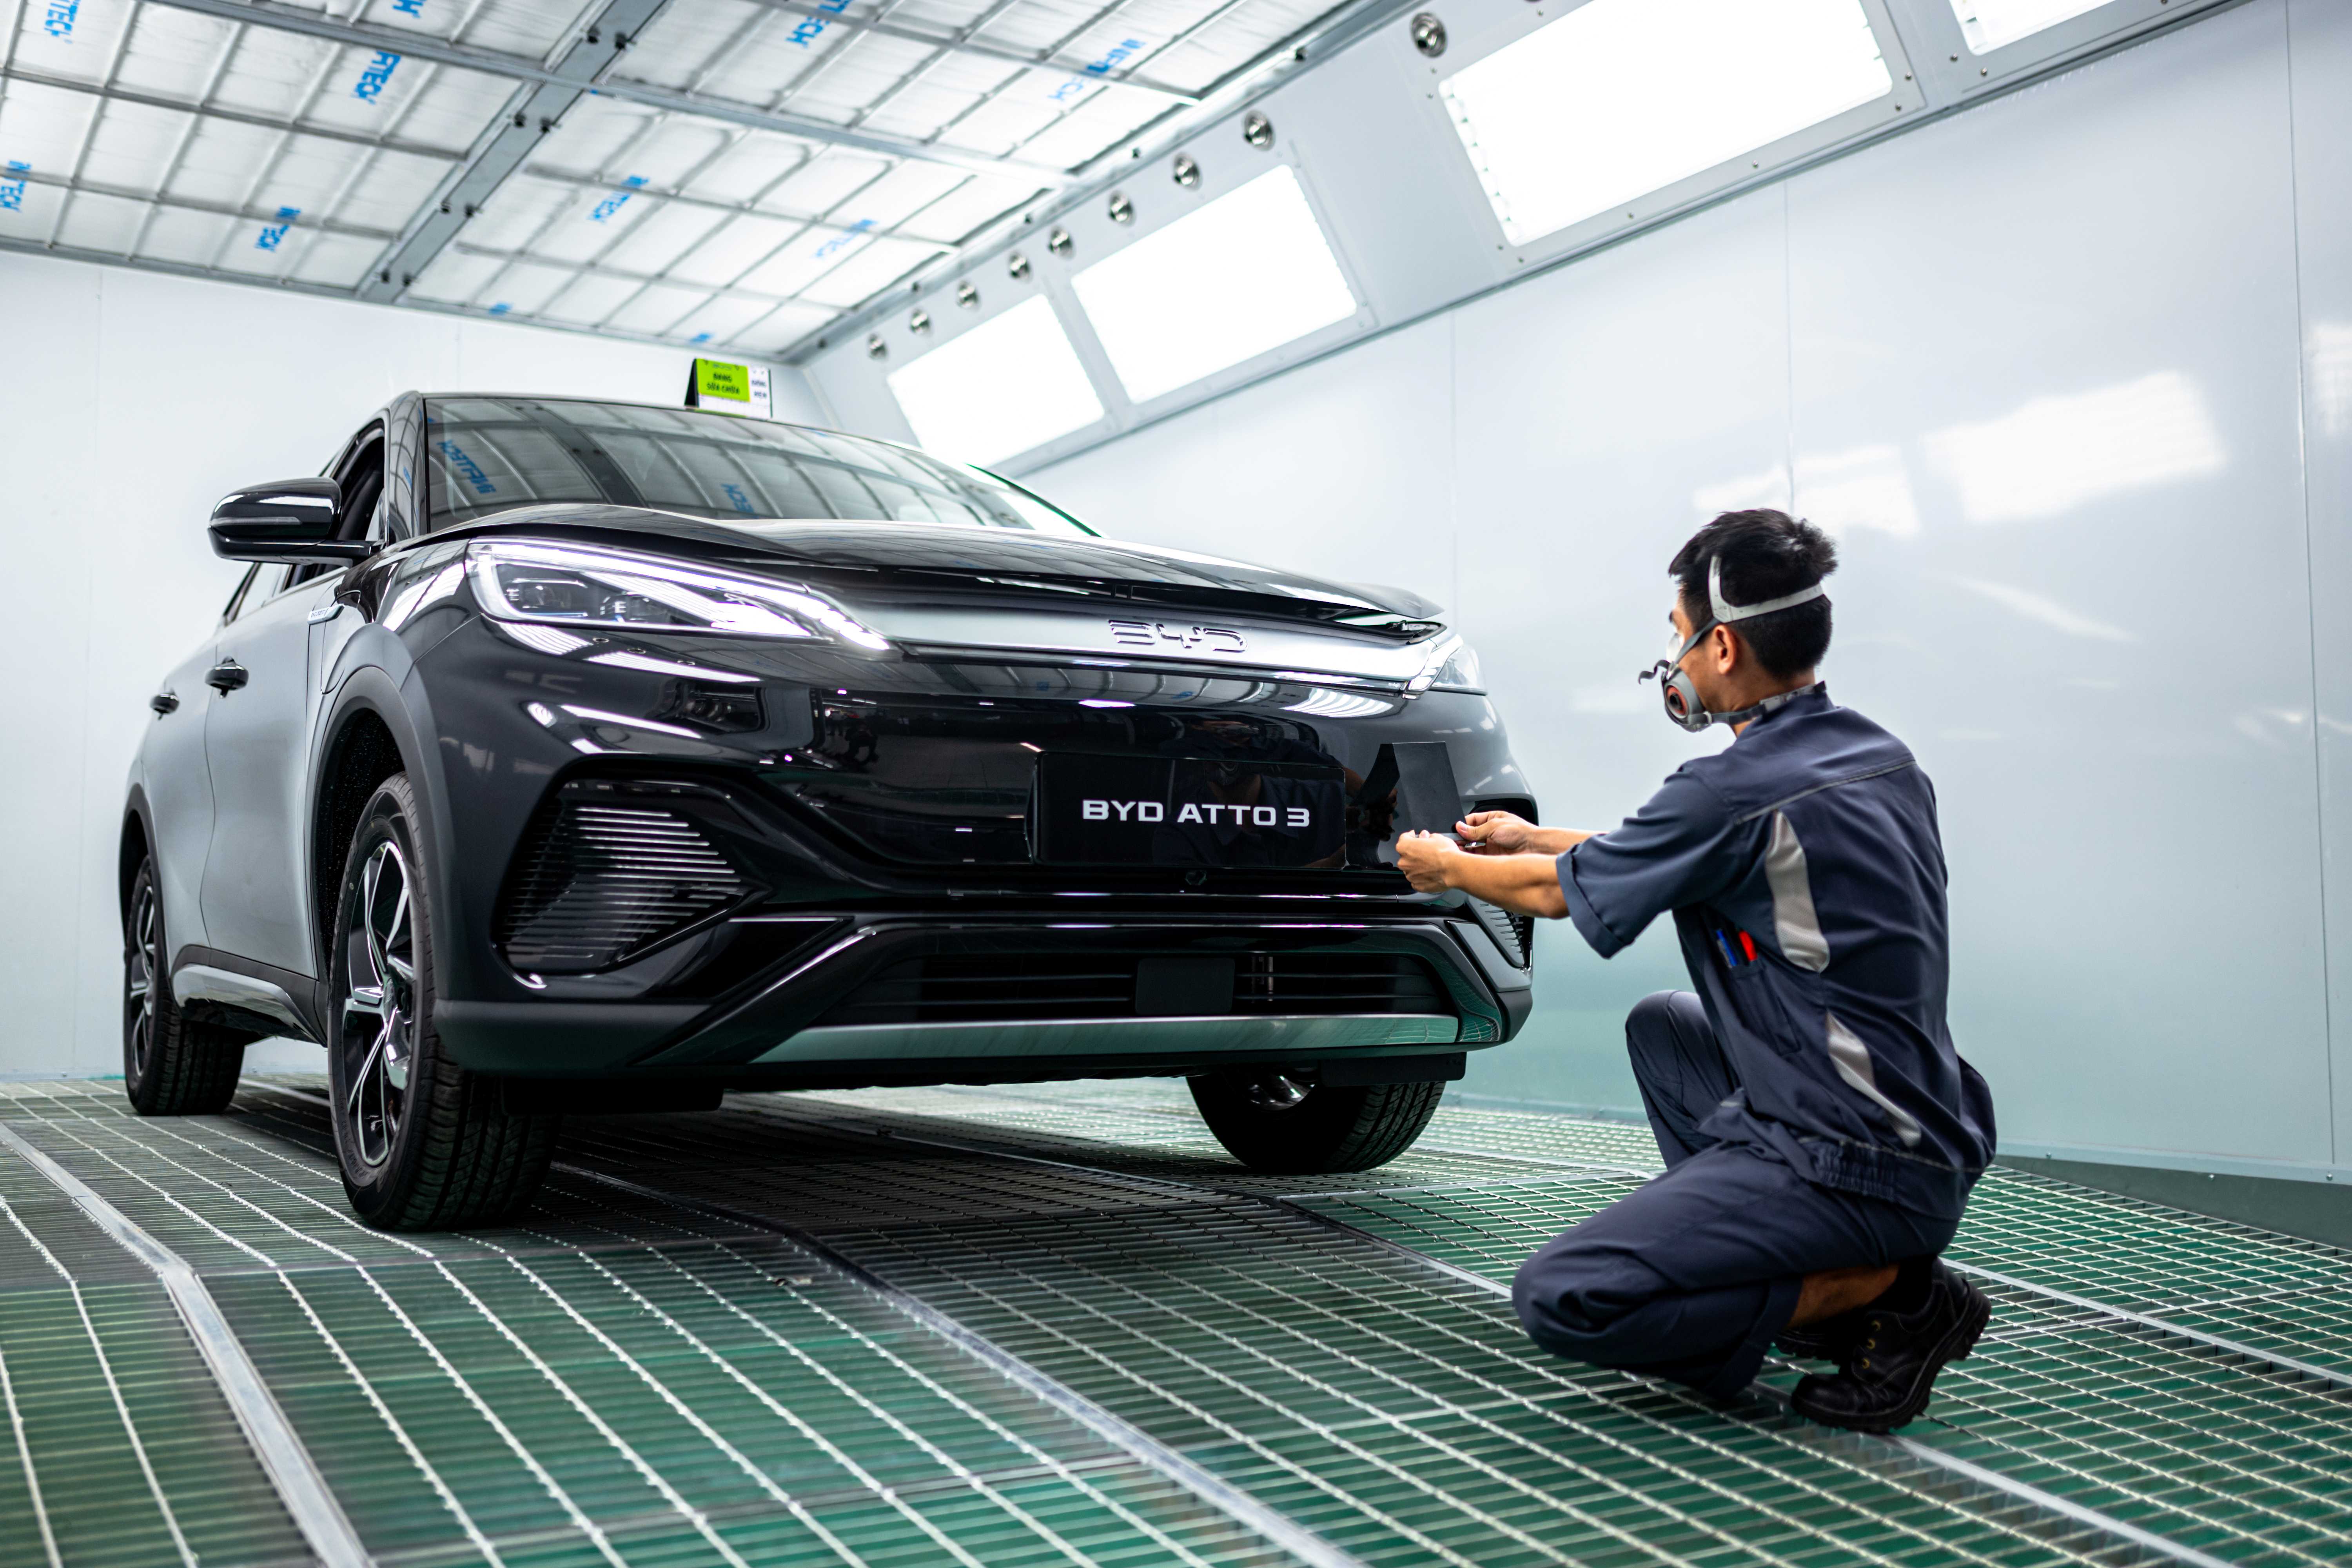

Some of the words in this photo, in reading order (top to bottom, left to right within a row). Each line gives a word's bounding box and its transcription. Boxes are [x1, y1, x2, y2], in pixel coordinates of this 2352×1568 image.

[1108, 619, 1248, 652] BYD
[1083, 800, 1163, 821] BYD
[1178, 804, 1276, 826] ATTO
[1287, 808, 1309, 826] 3
